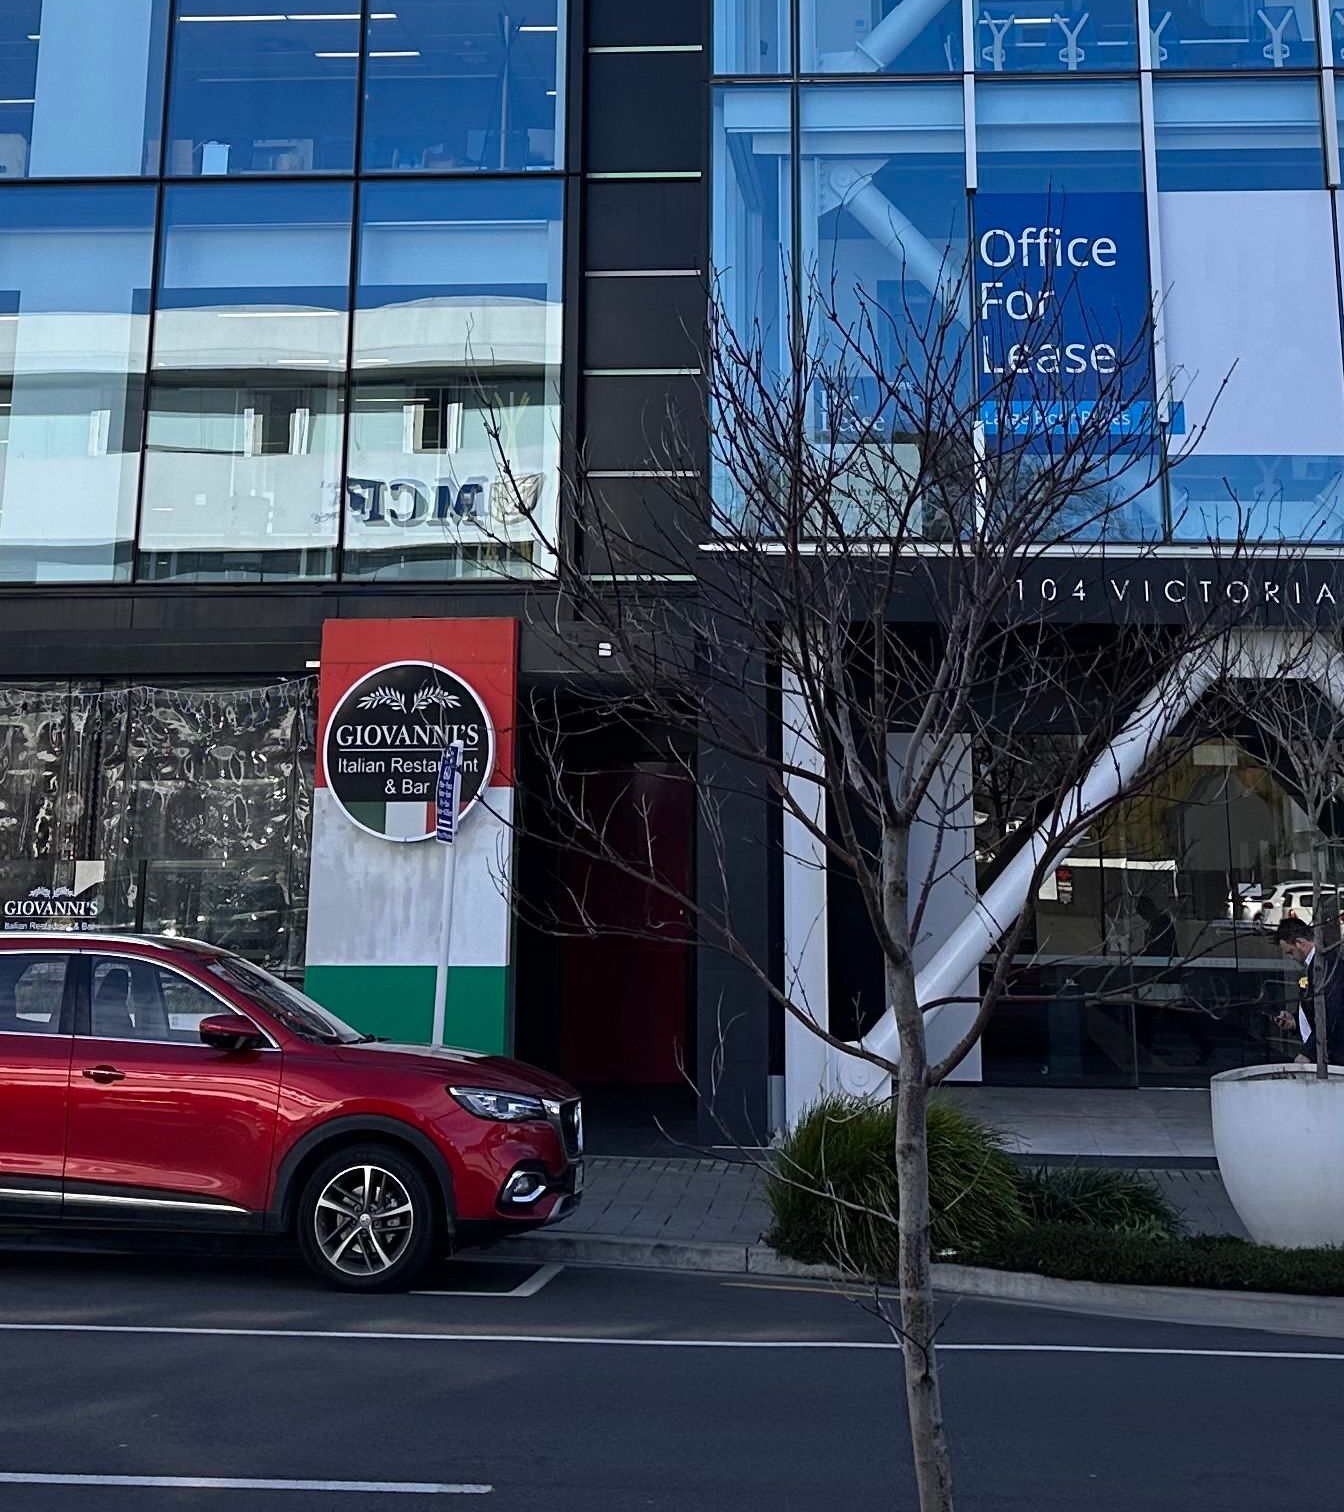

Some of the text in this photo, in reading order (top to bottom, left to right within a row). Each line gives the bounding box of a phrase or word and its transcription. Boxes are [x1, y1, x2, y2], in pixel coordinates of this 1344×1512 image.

[980, 227, 1117, 268] Office
[981, 282, 1055, 320] For
[983, 335, 1116, 374] Lease
[1015, 578, 1087, 602] 104
[1110, 579, 1337, 605] VICTORIA
[336, 724, 479, 746] GIOVANNI'S
[338, 757, 479, 774] Italian Restant
[384, 778, 431, 795] & Bar
[4, 900, 99, 916] GIOVANNI'S
